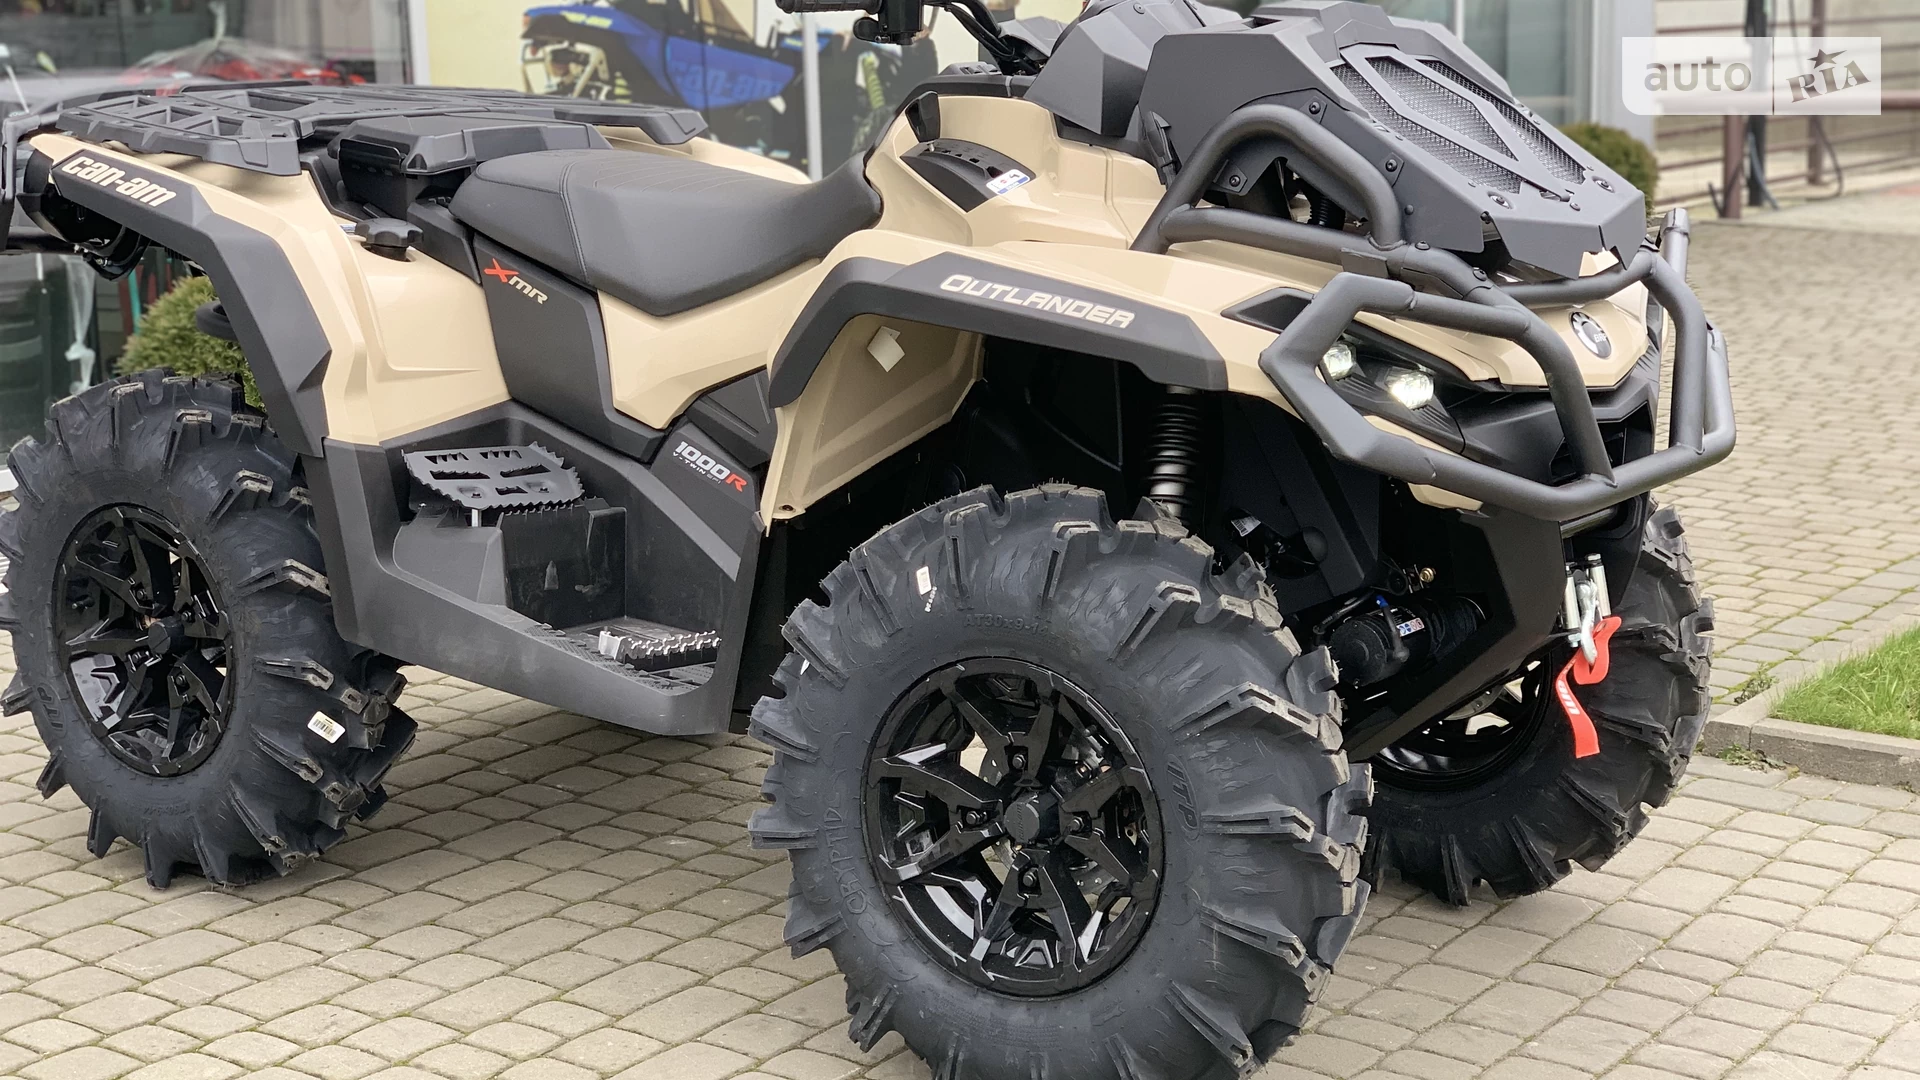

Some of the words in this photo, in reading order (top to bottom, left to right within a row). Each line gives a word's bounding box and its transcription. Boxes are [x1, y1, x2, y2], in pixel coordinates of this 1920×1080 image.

[61, 156, 177, 208] can-am
[940, 274, 1136, 329] OUTLANDER
[672, 451, 707, 475] V-TWIN
[675, 441, 748, 493] 1000R
[1167, 761, 1199, 829] ITP
